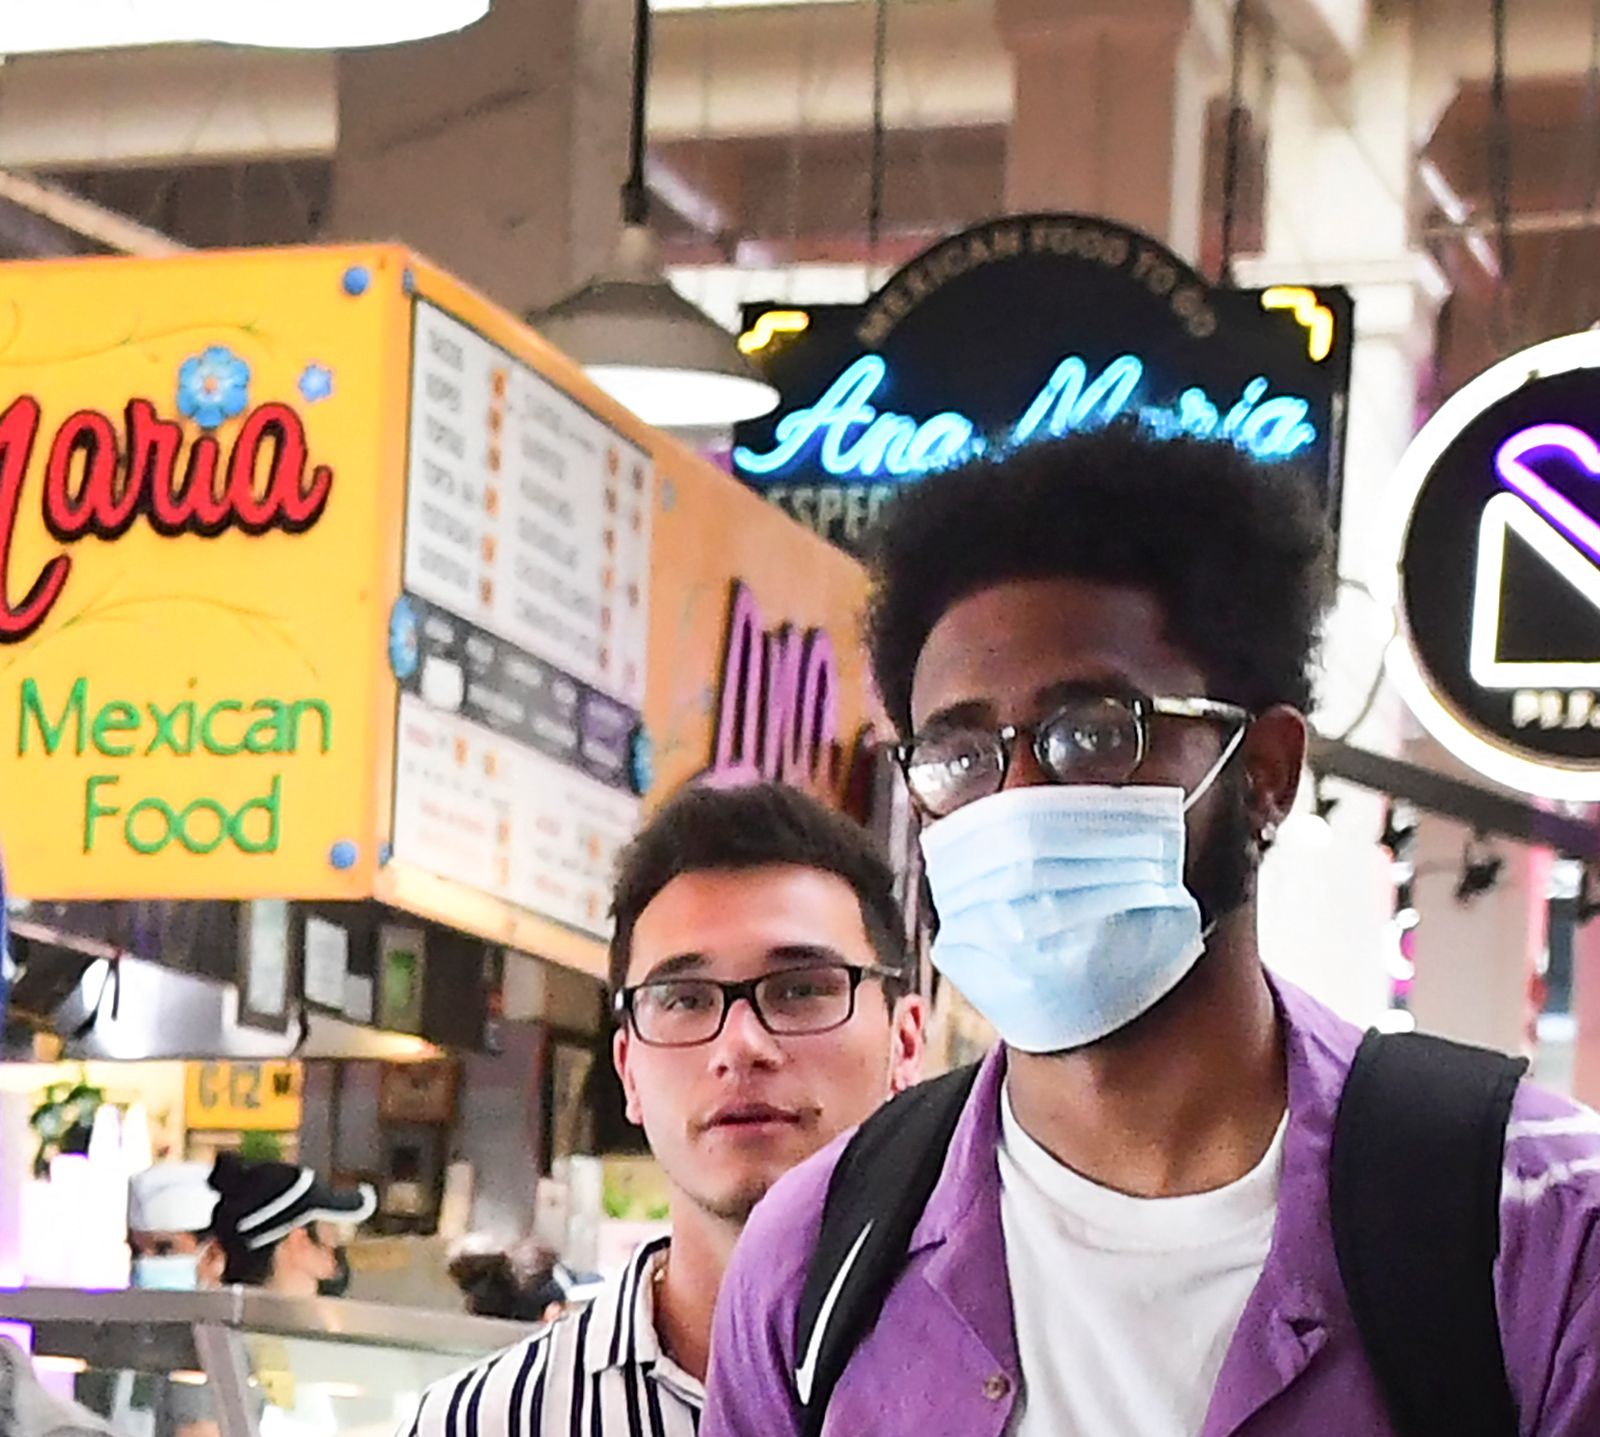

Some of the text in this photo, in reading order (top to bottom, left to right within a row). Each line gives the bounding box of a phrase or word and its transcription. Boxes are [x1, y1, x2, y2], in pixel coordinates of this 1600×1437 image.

[1030, 226, 1129, 268] FOOD
[734, 354, 986, 475] Ana
[17, 676, 333, 757] Mexican
[82, 773, 282, 855] Food
